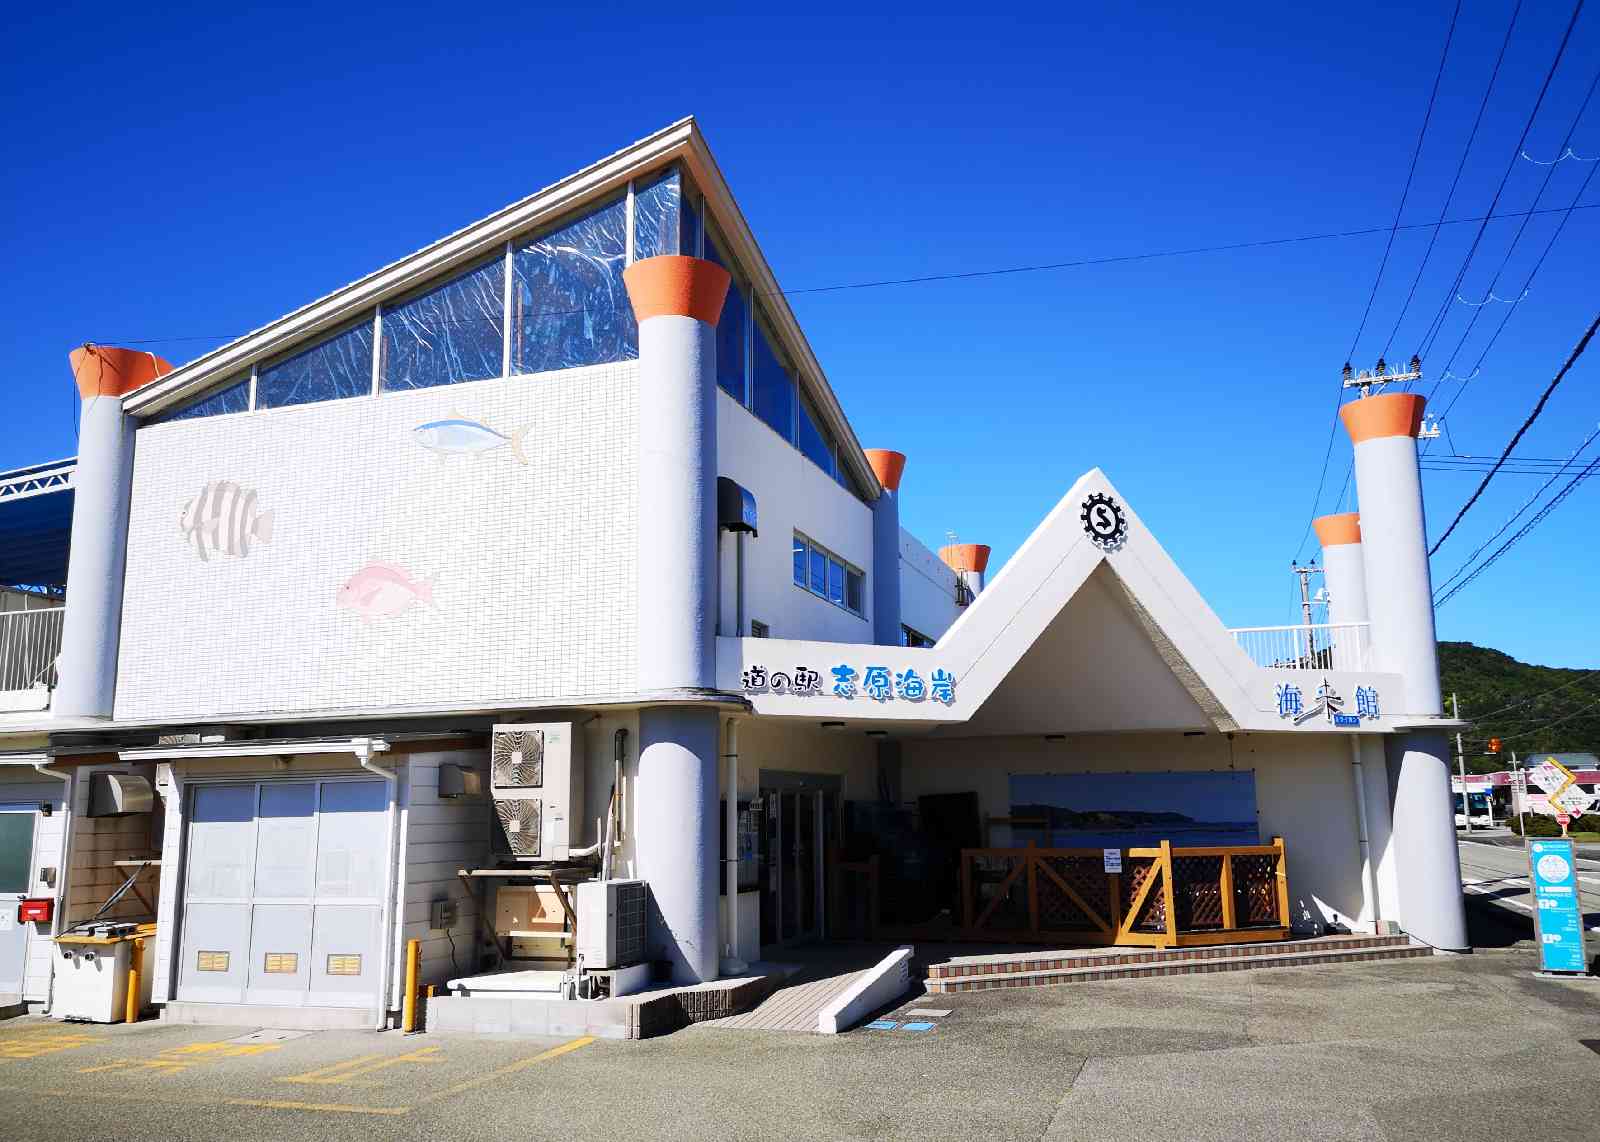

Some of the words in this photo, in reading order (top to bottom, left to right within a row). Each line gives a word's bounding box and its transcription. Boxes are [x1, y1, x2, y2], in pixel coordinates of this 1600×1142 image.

[742, 665, 820, 692] 道の駅
[831, 664, 956, 700] 志原海岸
